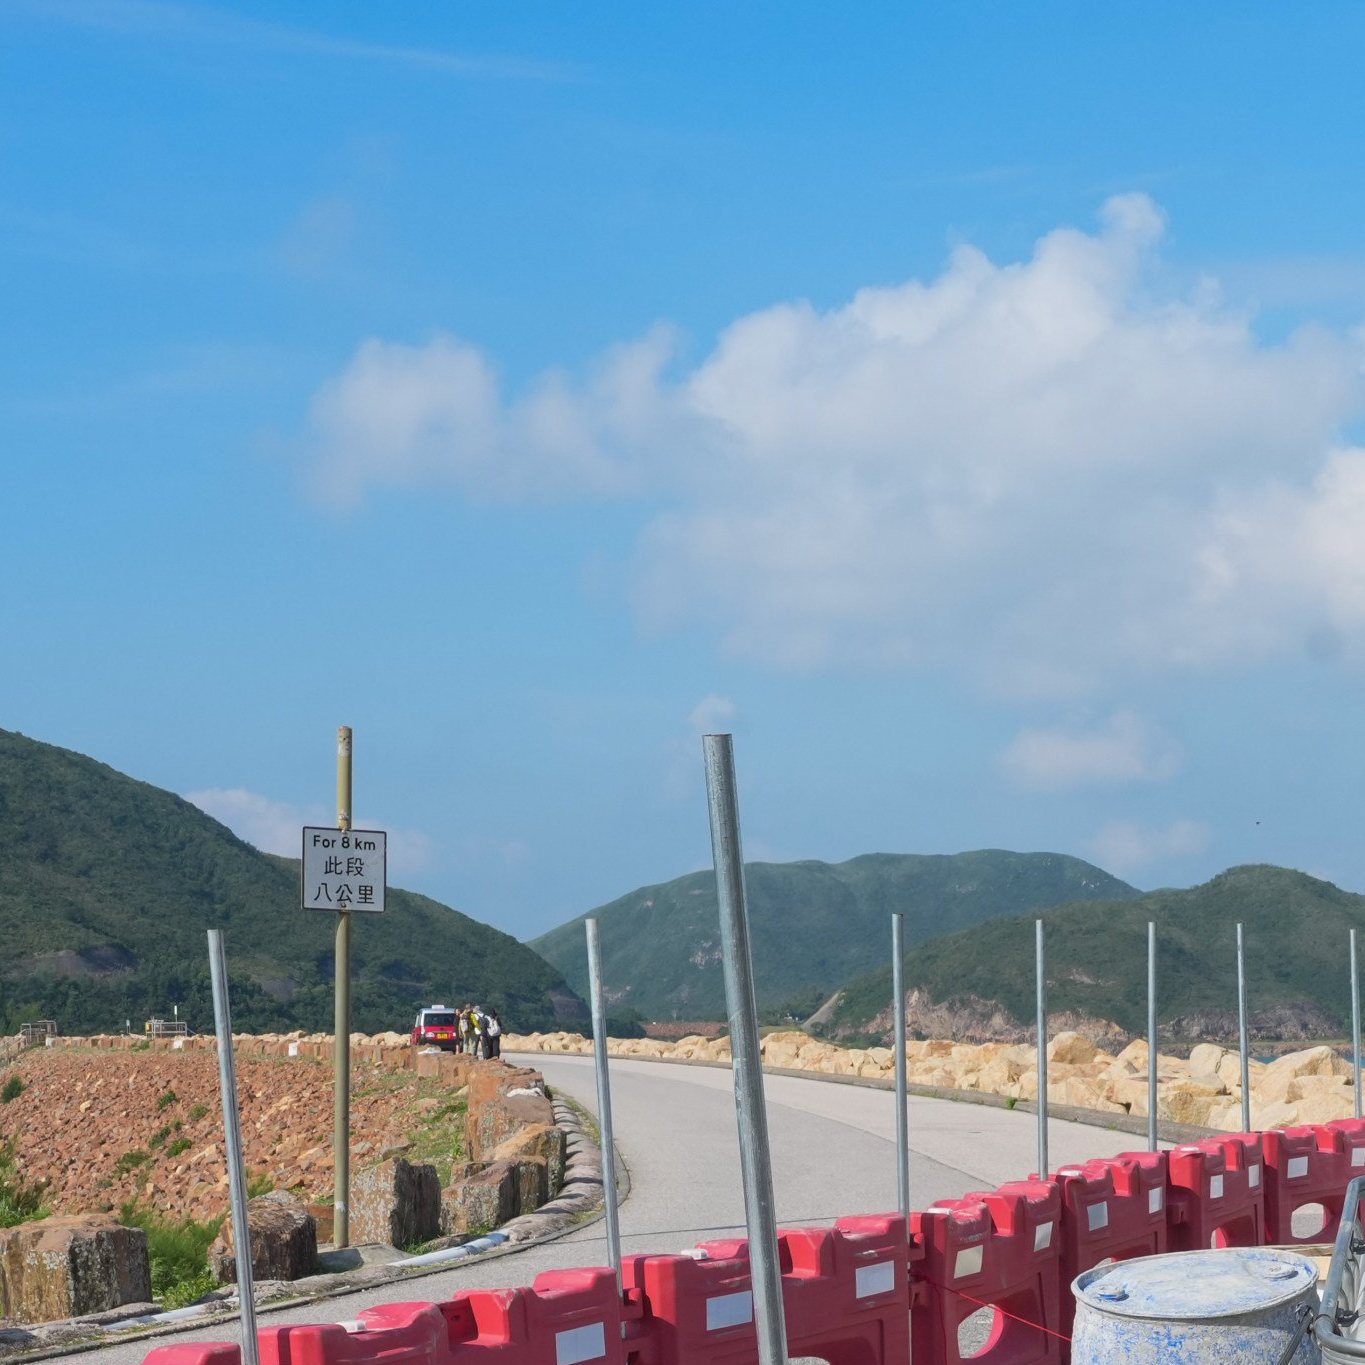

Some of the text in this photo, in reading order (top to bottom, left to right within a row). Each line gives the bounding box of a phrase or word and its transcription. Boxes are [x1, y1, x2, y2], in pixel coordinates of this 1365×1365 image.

[313, 835, 376, 851] For 8 km
[324, 856, 364, 877] 此段
[314, 882, 375, 904] 八公里
